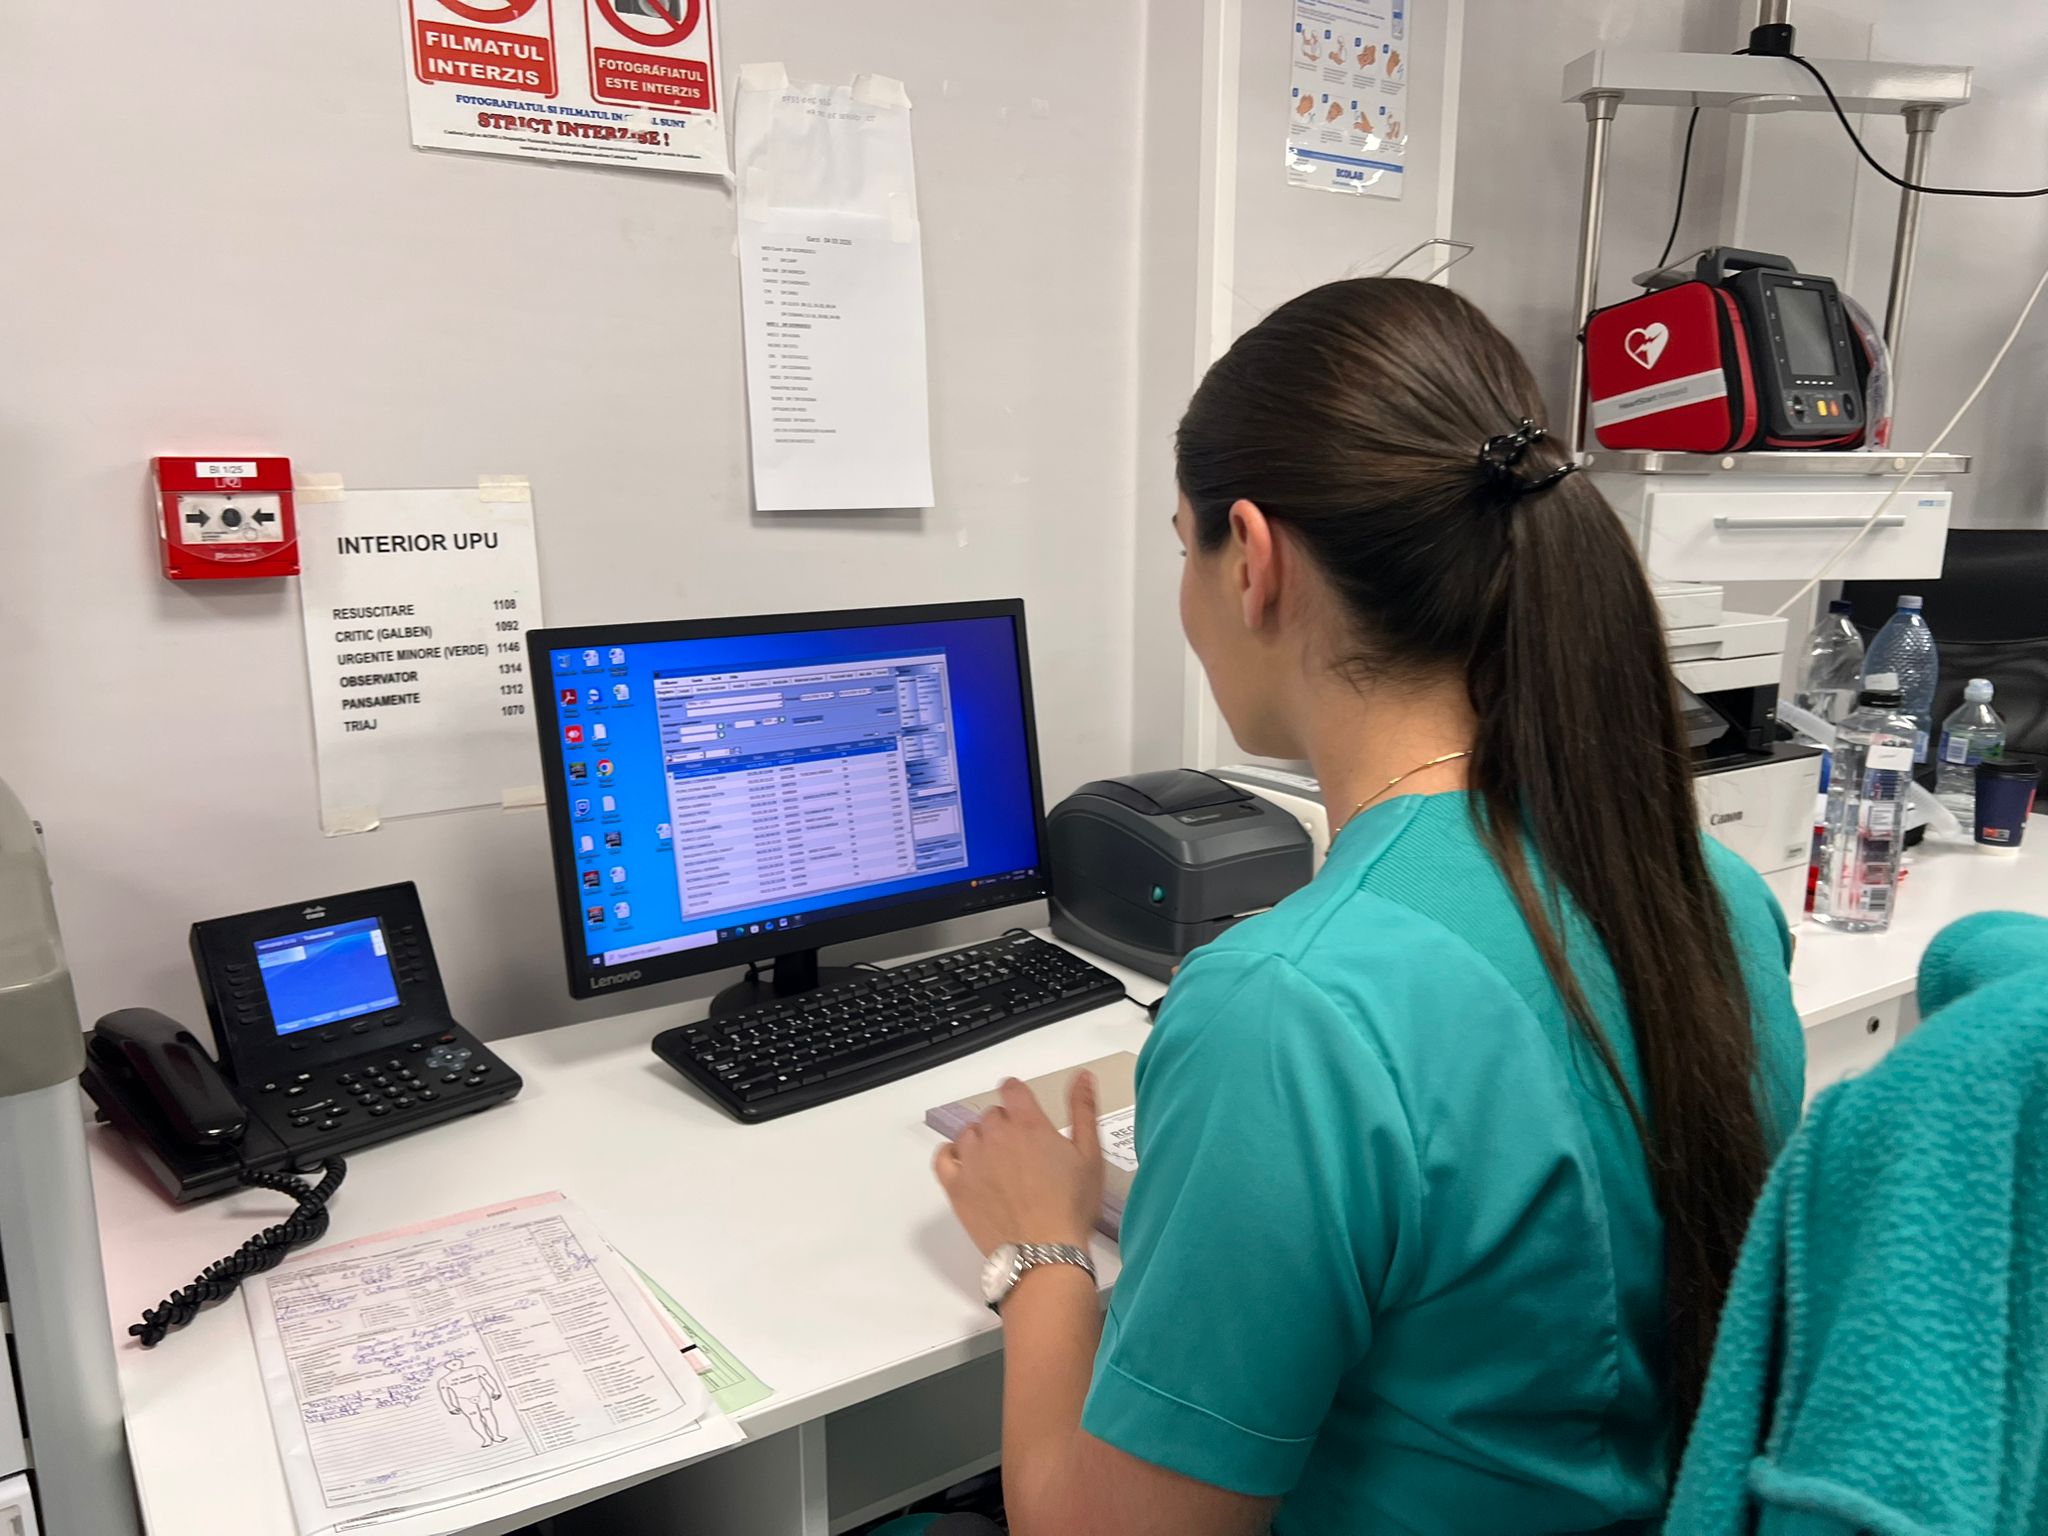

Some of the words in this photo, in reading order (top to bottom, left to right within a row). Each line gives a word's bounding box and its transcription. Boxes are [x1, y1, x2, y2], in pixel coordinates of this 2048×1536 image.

[425, 31, 545, 61] FILMATUL
[427, 57, 541, 86] INTERZIS
[598, 58, 705, 82] FOTOGRAFIATUL
[605, 77, 639, 92] ESTE
[642, 82, 701, 98] INTERZIS
[456, 94, 546, 113] FOTOGRAFIATUL
[560, 107, 610, 120] FILMATUL
[660, 118, 686, 129] SUNT
[477, 112, 553, 135] STRICT
[337, 534, 447, 555] INTERIOR
[453, 532, 499, 550] UPU
[333, 604, 415, 620] RESUSCITARE
[493, 599, 517, 611] 1108
[335, 629, 374, 643] CRITIC
[377, 625, 433, 643] (GALBEN)
[495, 620, 519, 632] 1092
[337, 650, 394, 666] URGENTE
[396, 647, 441, 661] MINORE
[444, 643, 489, 660] (VERDE)
[497, 641, 520, 654] 1146
[340, 671, 419, 688] OBSERVATOR
[498, 663, 523, 675] 1314
[341, 693, 421, 710] PANSAMENTE
[500, 684, 524, 696] 1312
[344, 719, 377, 732] TRIAJ
[501, 705, 525, 717] 1070
[1710, 810, 1744, 826] Canon
[589, 968, 642, 989] Lenovo
